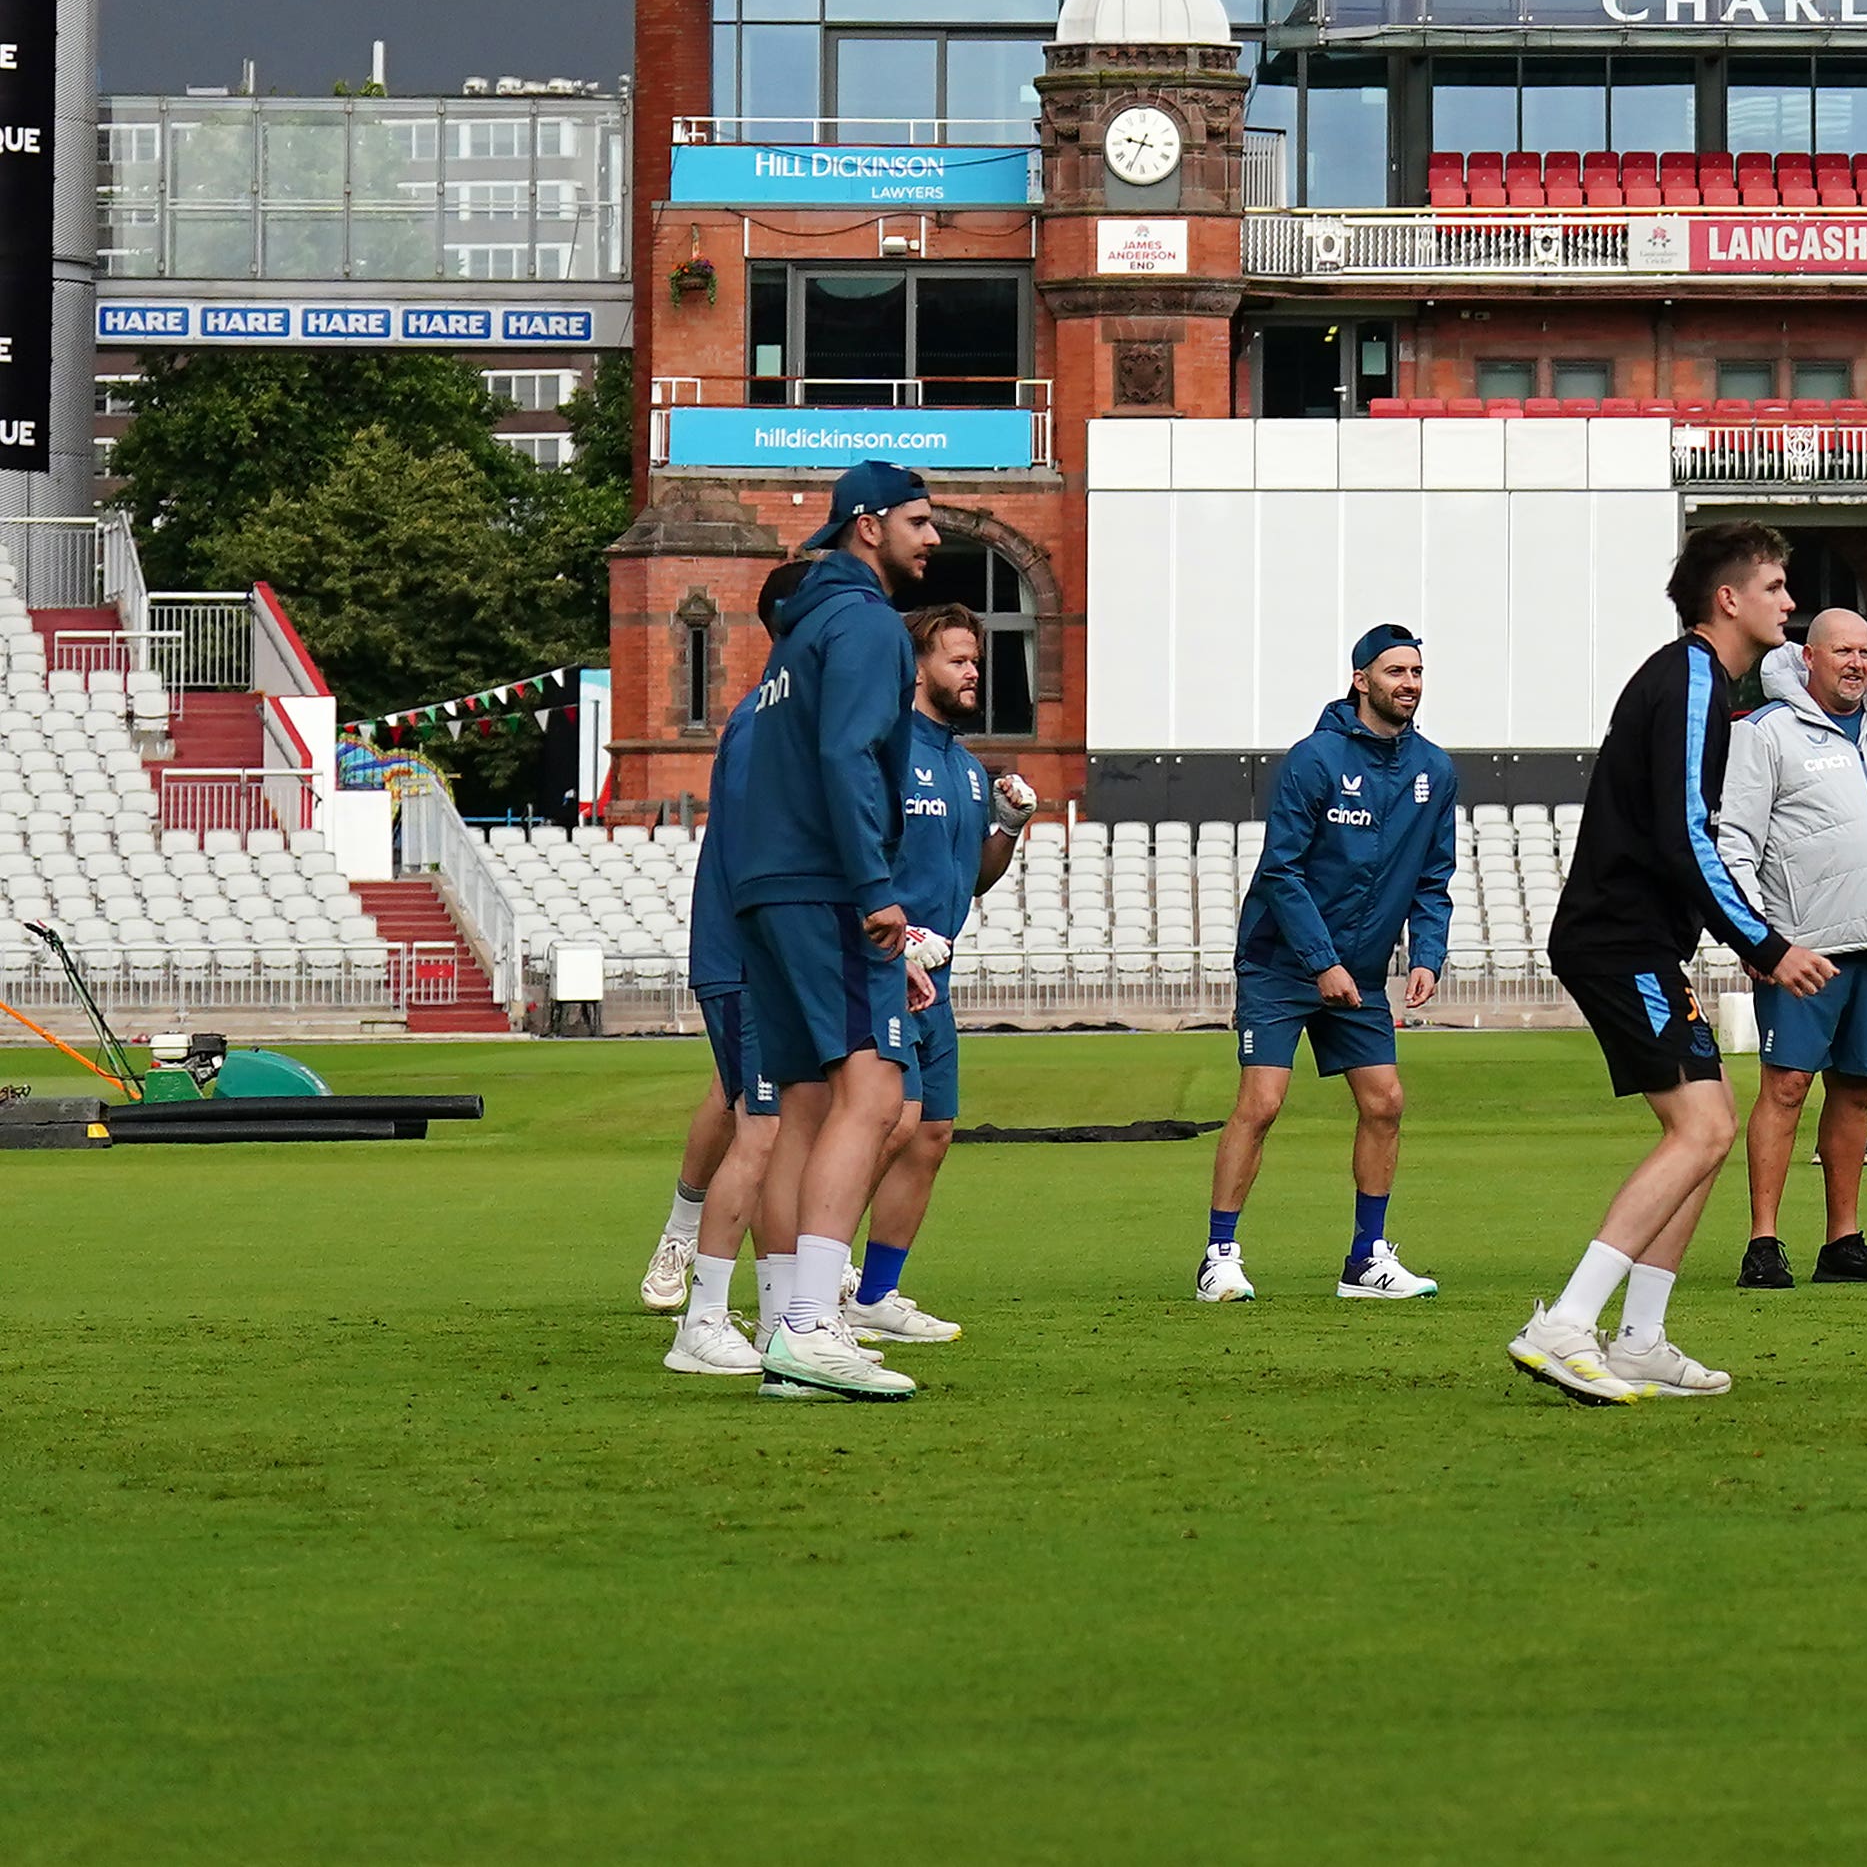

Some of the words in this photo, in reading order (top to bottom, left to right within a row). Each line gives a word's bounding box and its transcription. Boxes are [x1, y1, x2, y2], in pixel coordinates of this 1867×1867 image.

[755, 152, 806, 177] HILL
[811, 152, 944, 178] DICKINSON
[871, 186, 944, 200] LAWYERS
[1108, 250, 1176, 260] ANDERSON
[1123, 241, 1162, 250] JAMES
[1129, 261, 1155, 270] END
[104, 311, 183, 332] HARE
[206, 311, 284, 333] HARE
[306, 312, 384, 334] HARE
[407, 313, 485, 335] HARE
[507, 314, 586, 337] HARE
[754, 427, 947, 450] hilldickinson.com
[1803, 754, 1853, 773] cinch
[905, 792, 947, 817] cinch
[1326, 803, 1372, 826] cinch
